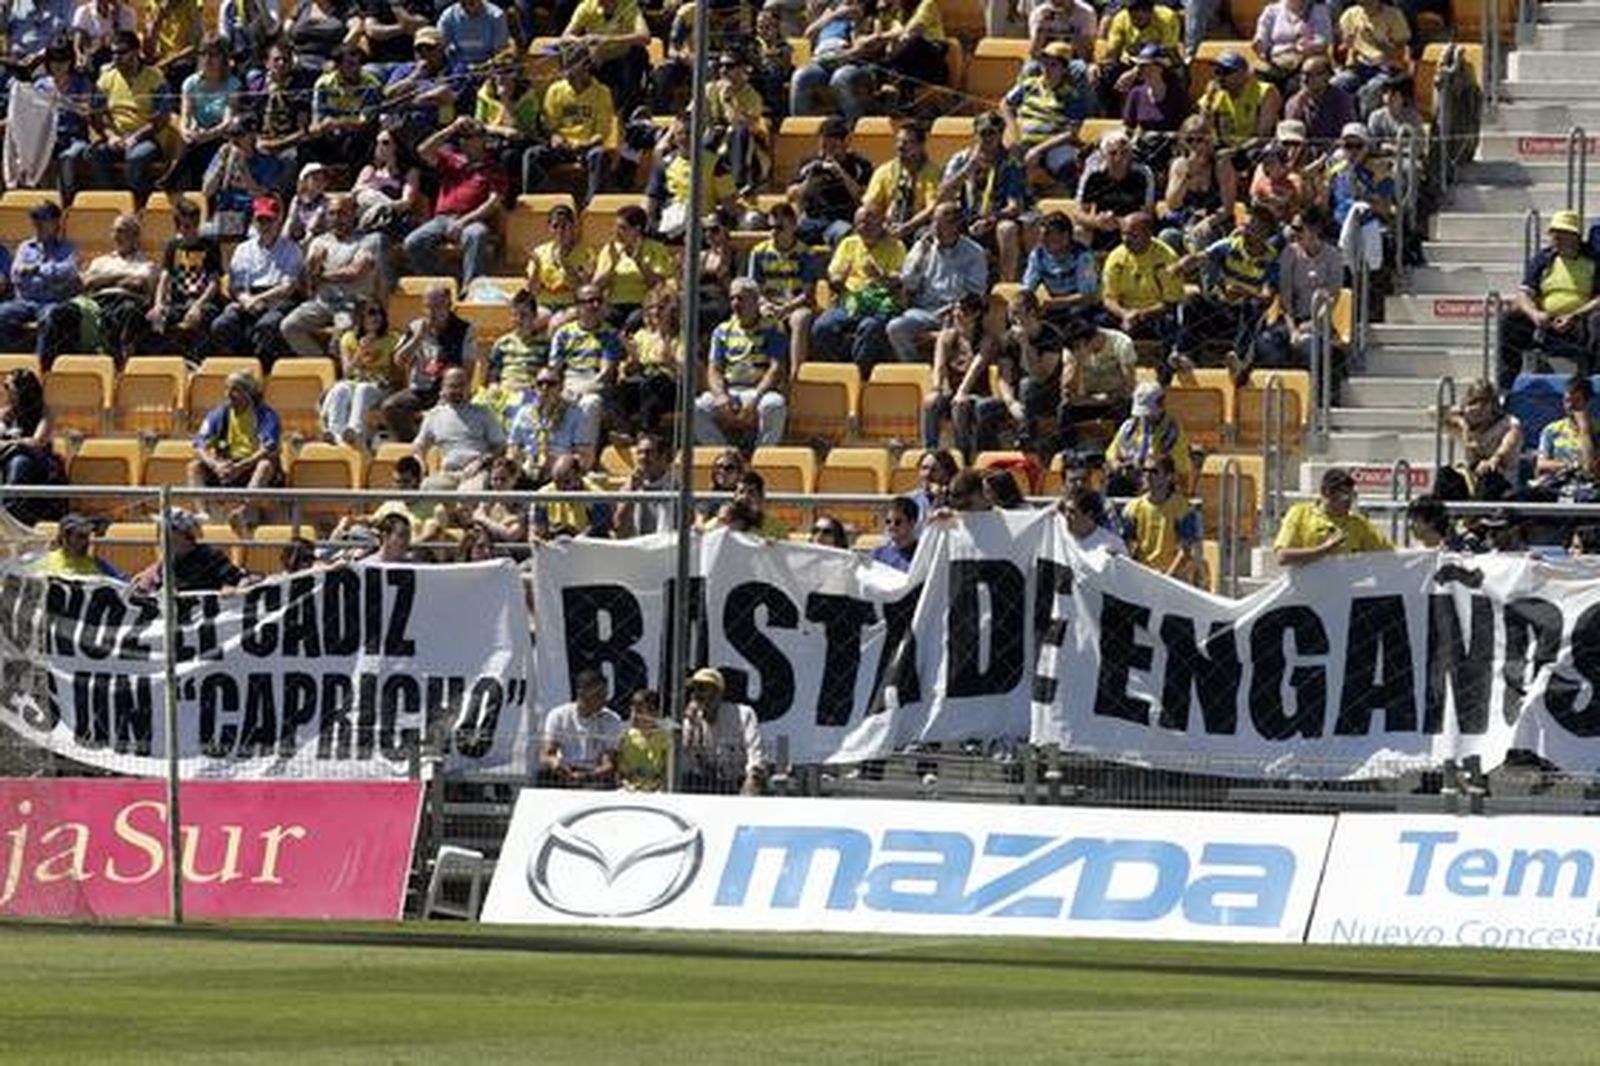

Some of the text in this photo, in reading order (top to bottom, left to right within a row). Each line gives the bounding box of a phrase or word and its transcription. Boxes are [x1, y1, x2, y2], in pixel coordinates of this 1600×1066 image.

[562, 574, 925, 726] BASTA
[946, 558, 1074, 705] DE
[74, 671, 152, 757] UN
[0, 799, 307, 903] jaSur
[713, 825, 1297, 928] mazda
[1331, 917, 1600, 948] Nuevo Concesi
